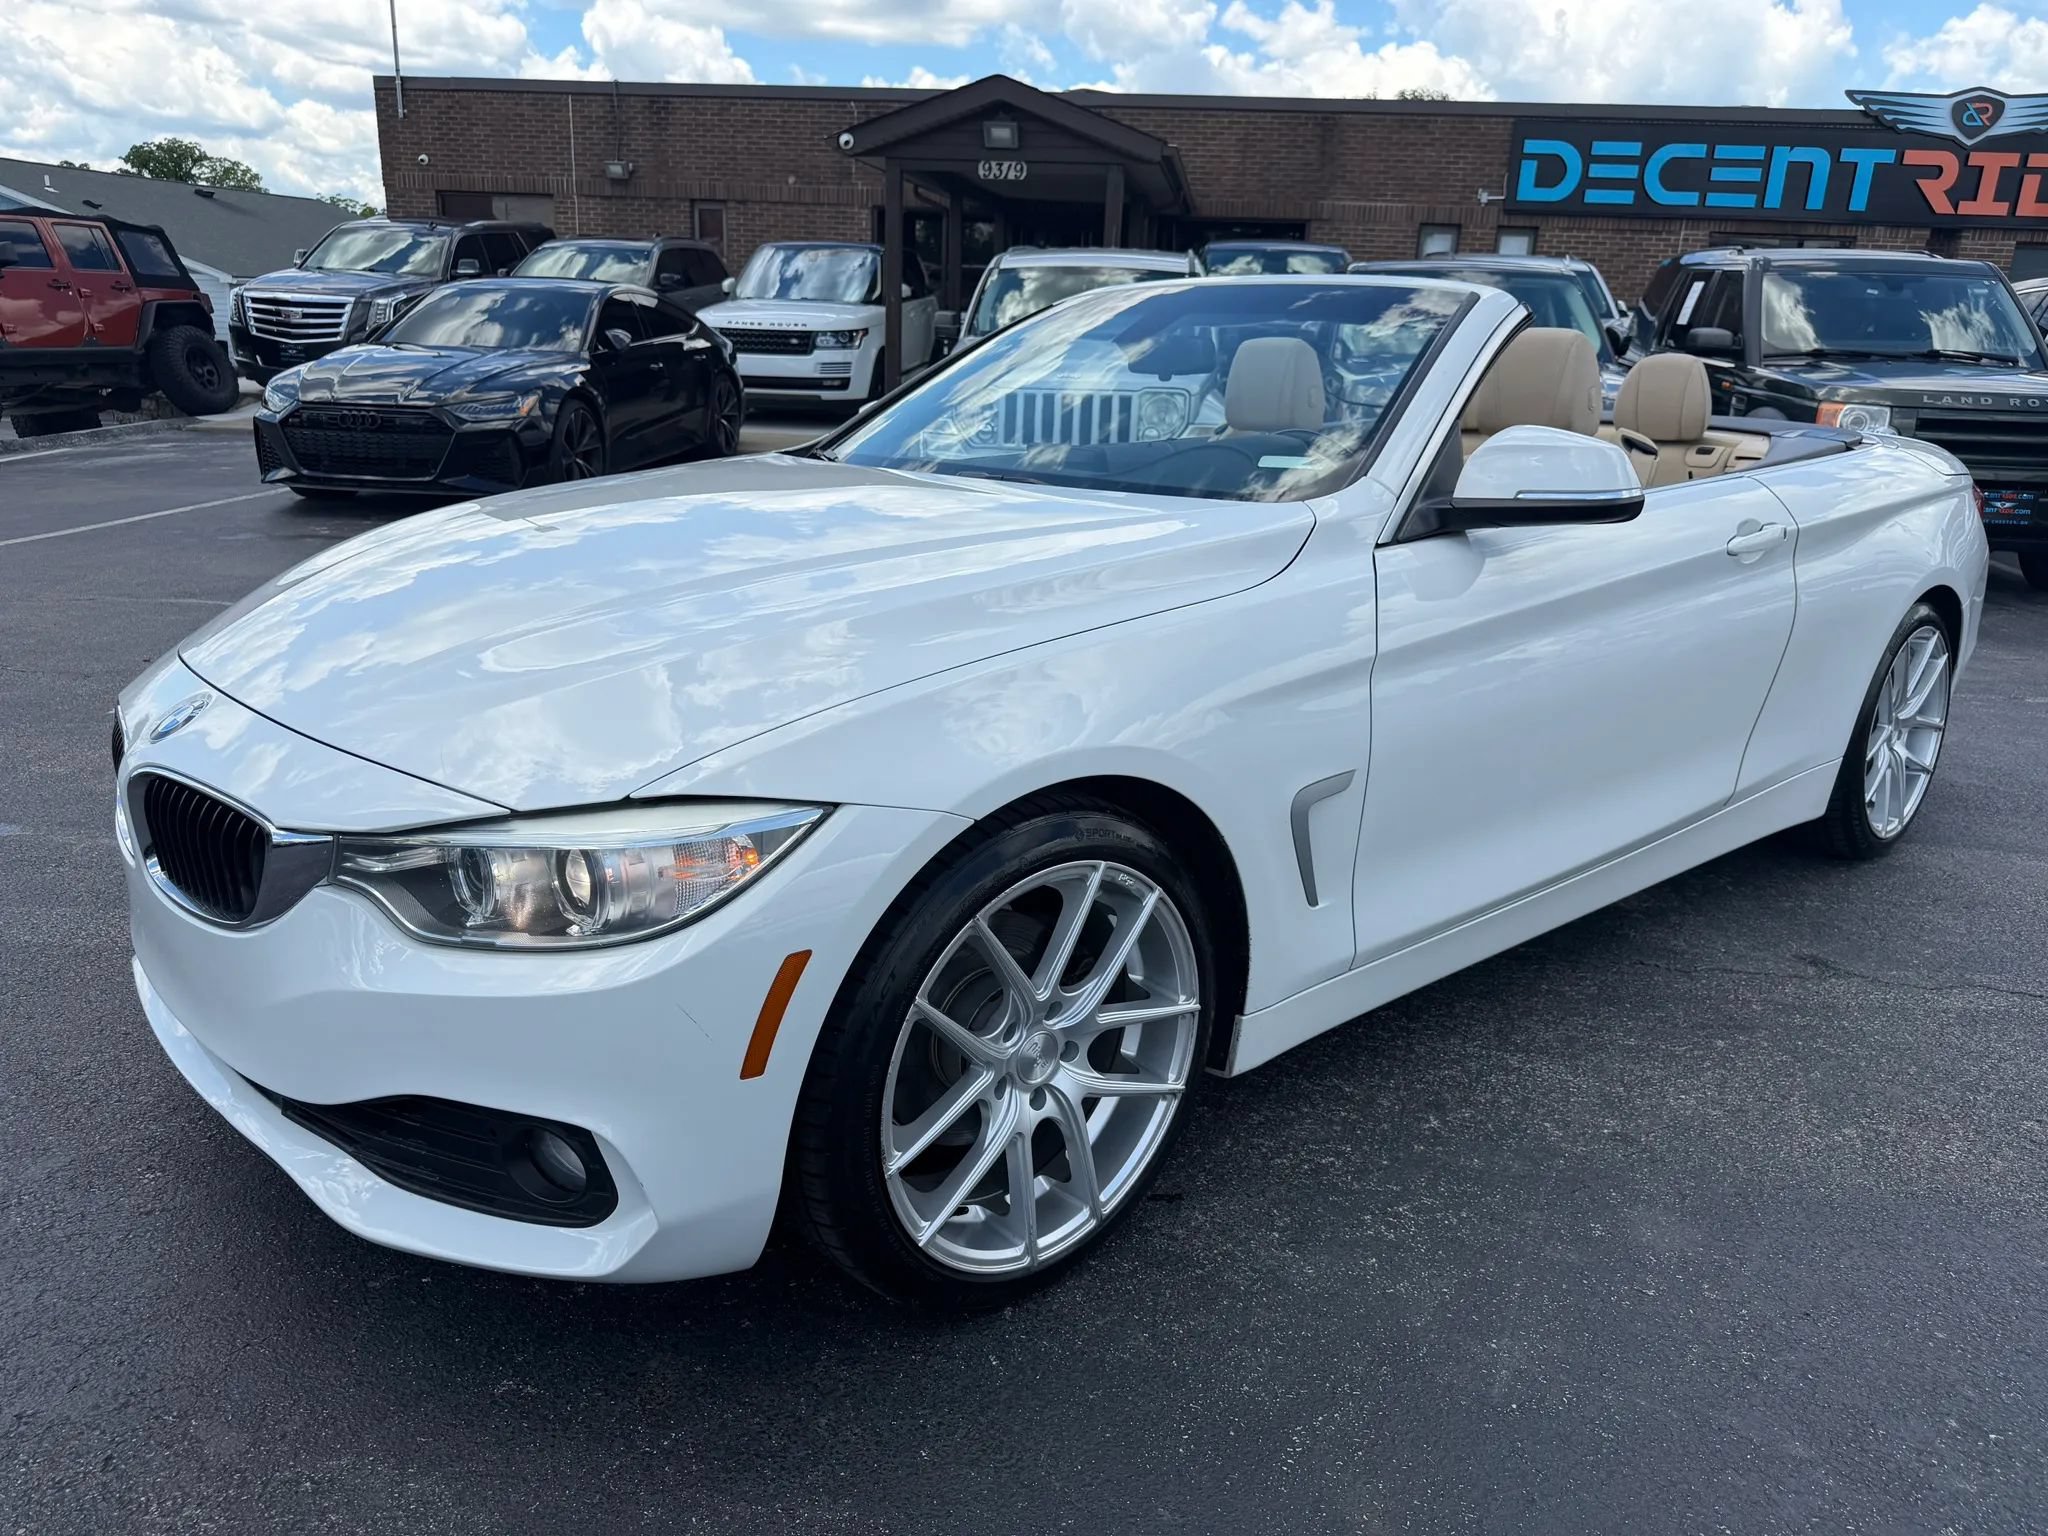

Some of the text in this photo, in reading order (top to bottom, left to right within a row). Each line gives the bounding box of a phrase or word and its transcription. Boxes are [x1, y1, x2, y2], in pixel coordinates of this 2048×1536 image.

[1517, 139, 1896, 212] DECENT
[1922, 395, 2048, 408] LAND RO
